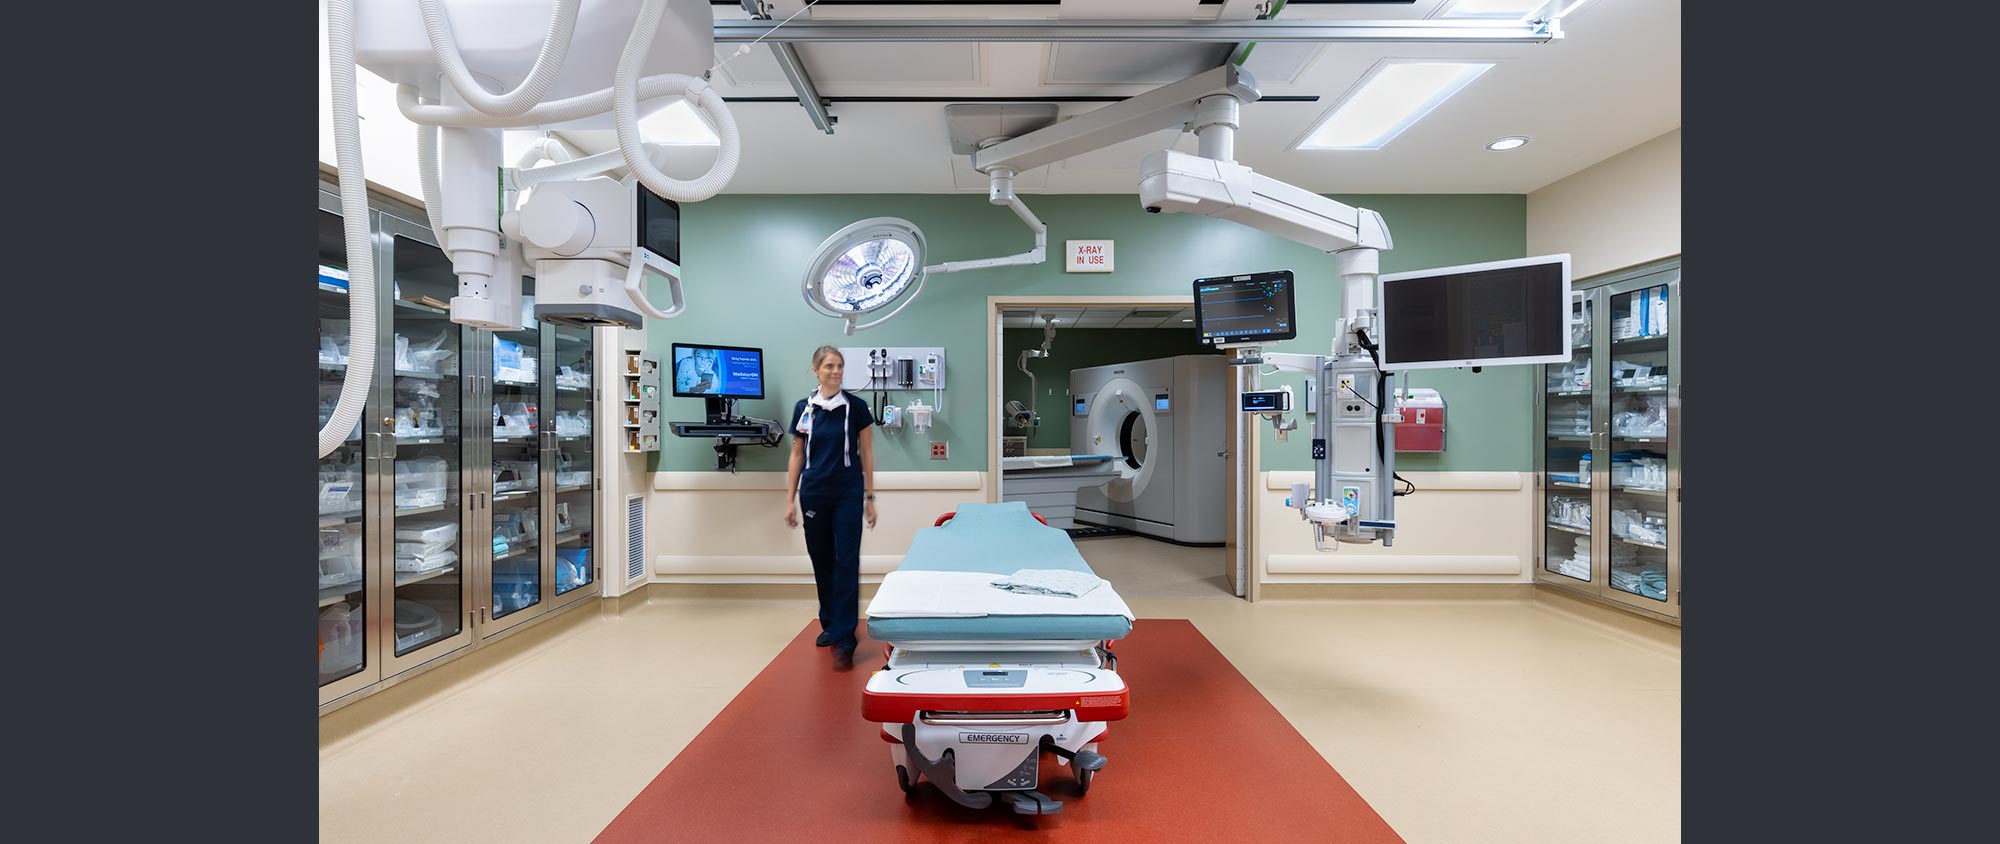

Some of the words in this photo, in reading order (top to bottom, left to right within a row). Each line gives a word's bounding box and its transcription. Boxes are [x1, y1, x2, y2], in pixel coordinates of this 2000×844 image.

[1078, 246, 1102, 254] X-RAY
[1076, 256, 1084, 264] IN
[1088, 256, 1104, 264] USE
[967, 734, 1020, 743] EMERGENCY
